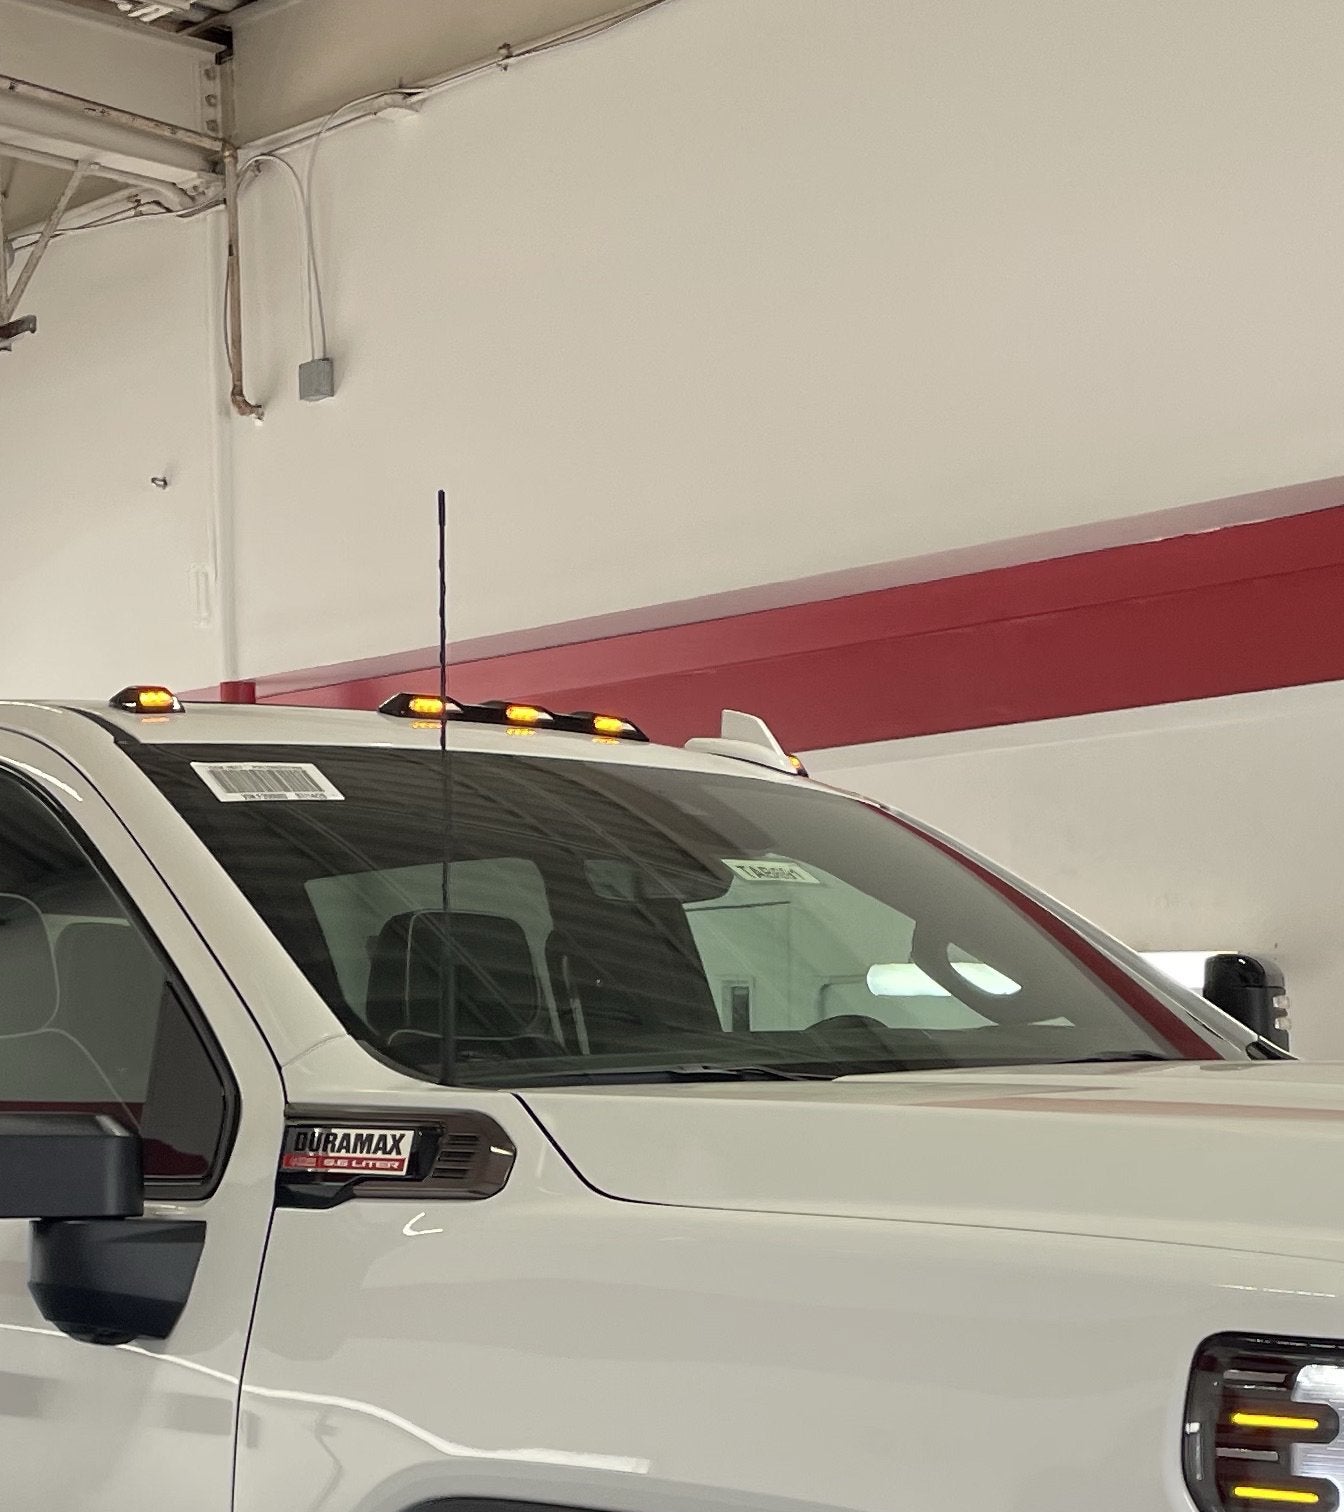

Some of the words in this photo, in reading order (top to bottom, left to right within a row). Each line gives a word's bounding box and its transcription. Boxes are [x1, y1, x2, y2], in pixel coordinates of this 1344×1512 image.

[294, 1131, 406, 1156] DURAMAX
[323, 1159, 348, 1167] 6.6
[352, 1160, 400, 1169] LITER
